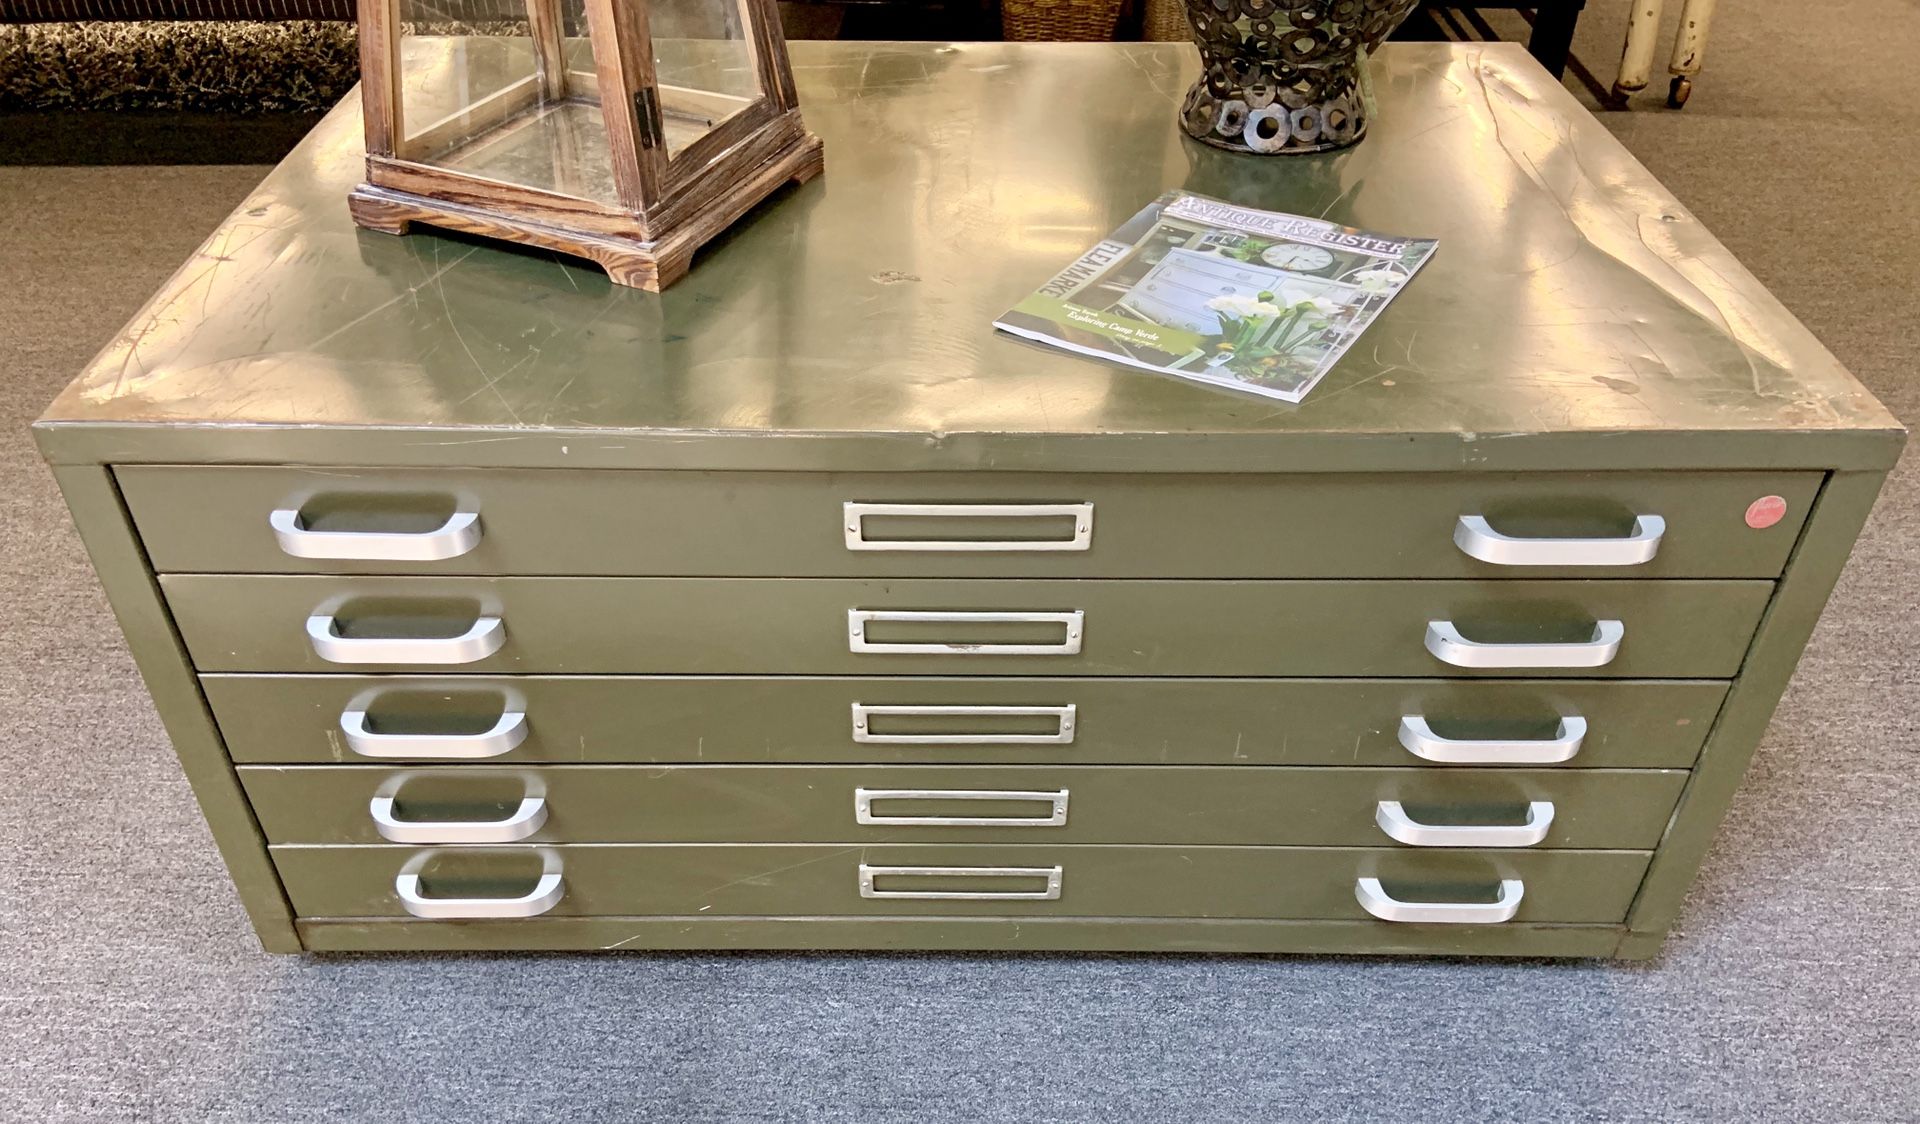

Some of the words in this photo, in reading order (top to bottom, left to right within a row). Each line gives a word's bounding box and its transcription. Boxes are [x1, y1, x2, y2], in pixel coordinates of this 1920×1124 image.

[1177, 196, 1275, 230] ANTIQUE
[1283, 219, 1406, 255] REGISTER
[1080, 242, 1124, 267] FLEA
[1067, 310, 1108, 328] Exploring
[1108, 322, 1134, 335] Camp
[1135, 328, 1160, 341] Verde
